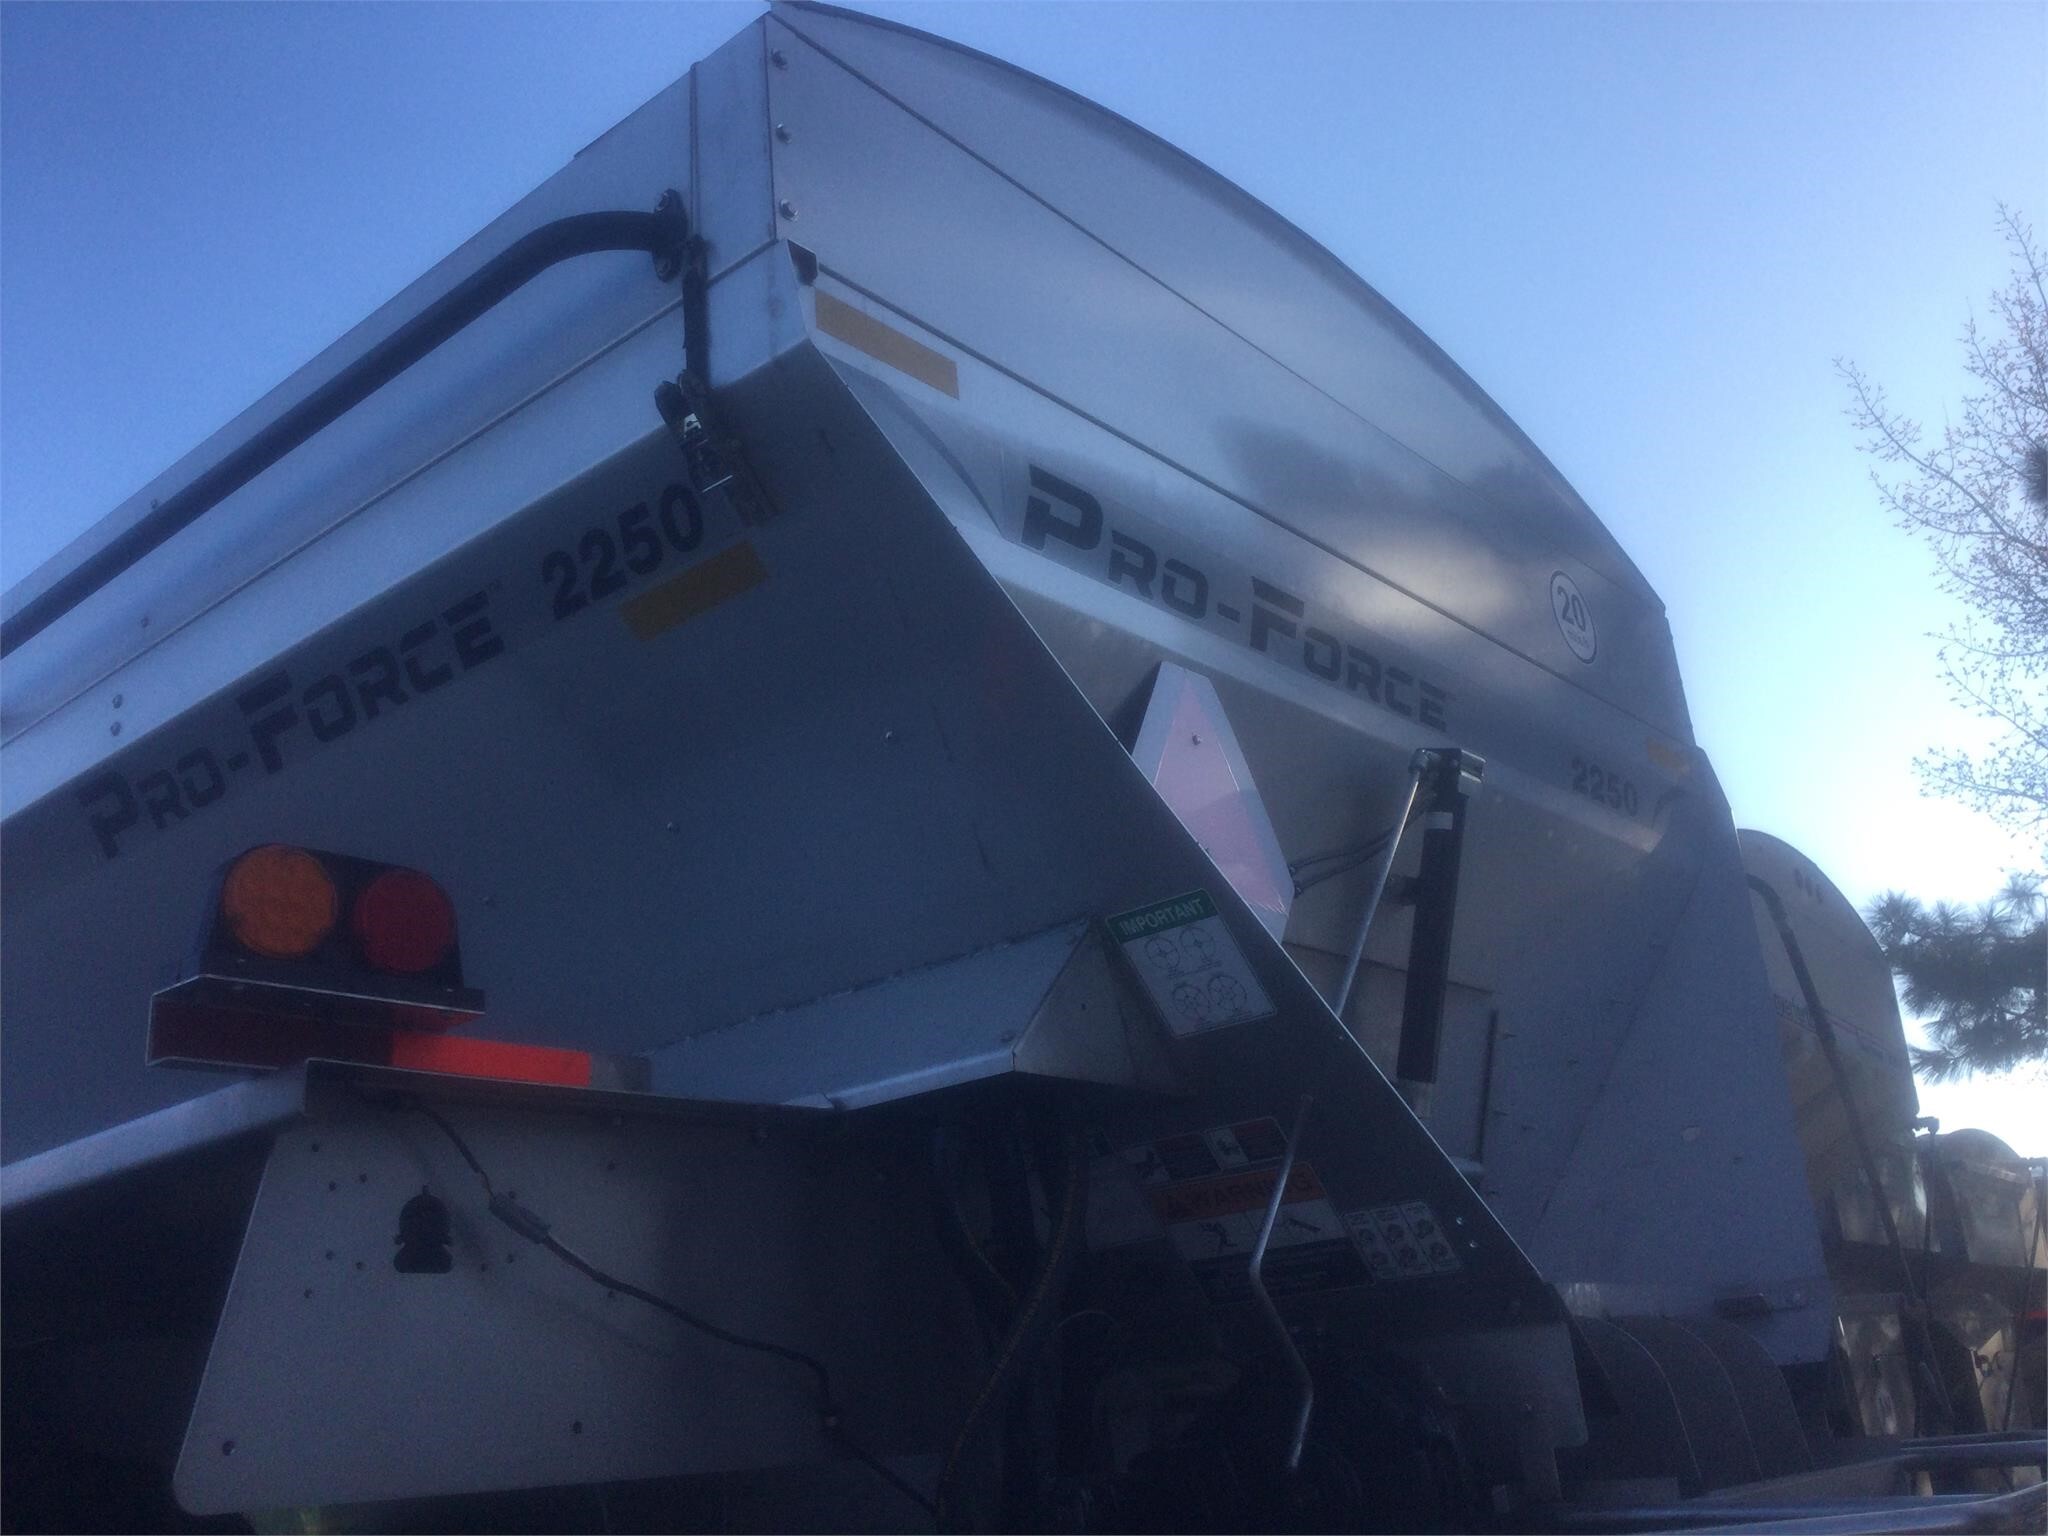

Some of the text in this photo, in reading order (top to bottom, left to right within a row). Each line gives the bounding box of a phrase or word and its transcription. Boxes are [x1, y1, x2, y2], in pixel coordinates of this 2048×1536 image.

[541, 483, 705, 623] 2250
[1556, 585, 1586, 632] 20
[1571, 756, 1639, 818] 2250
[1119, 898, 1204, 937] IMPORTANT
